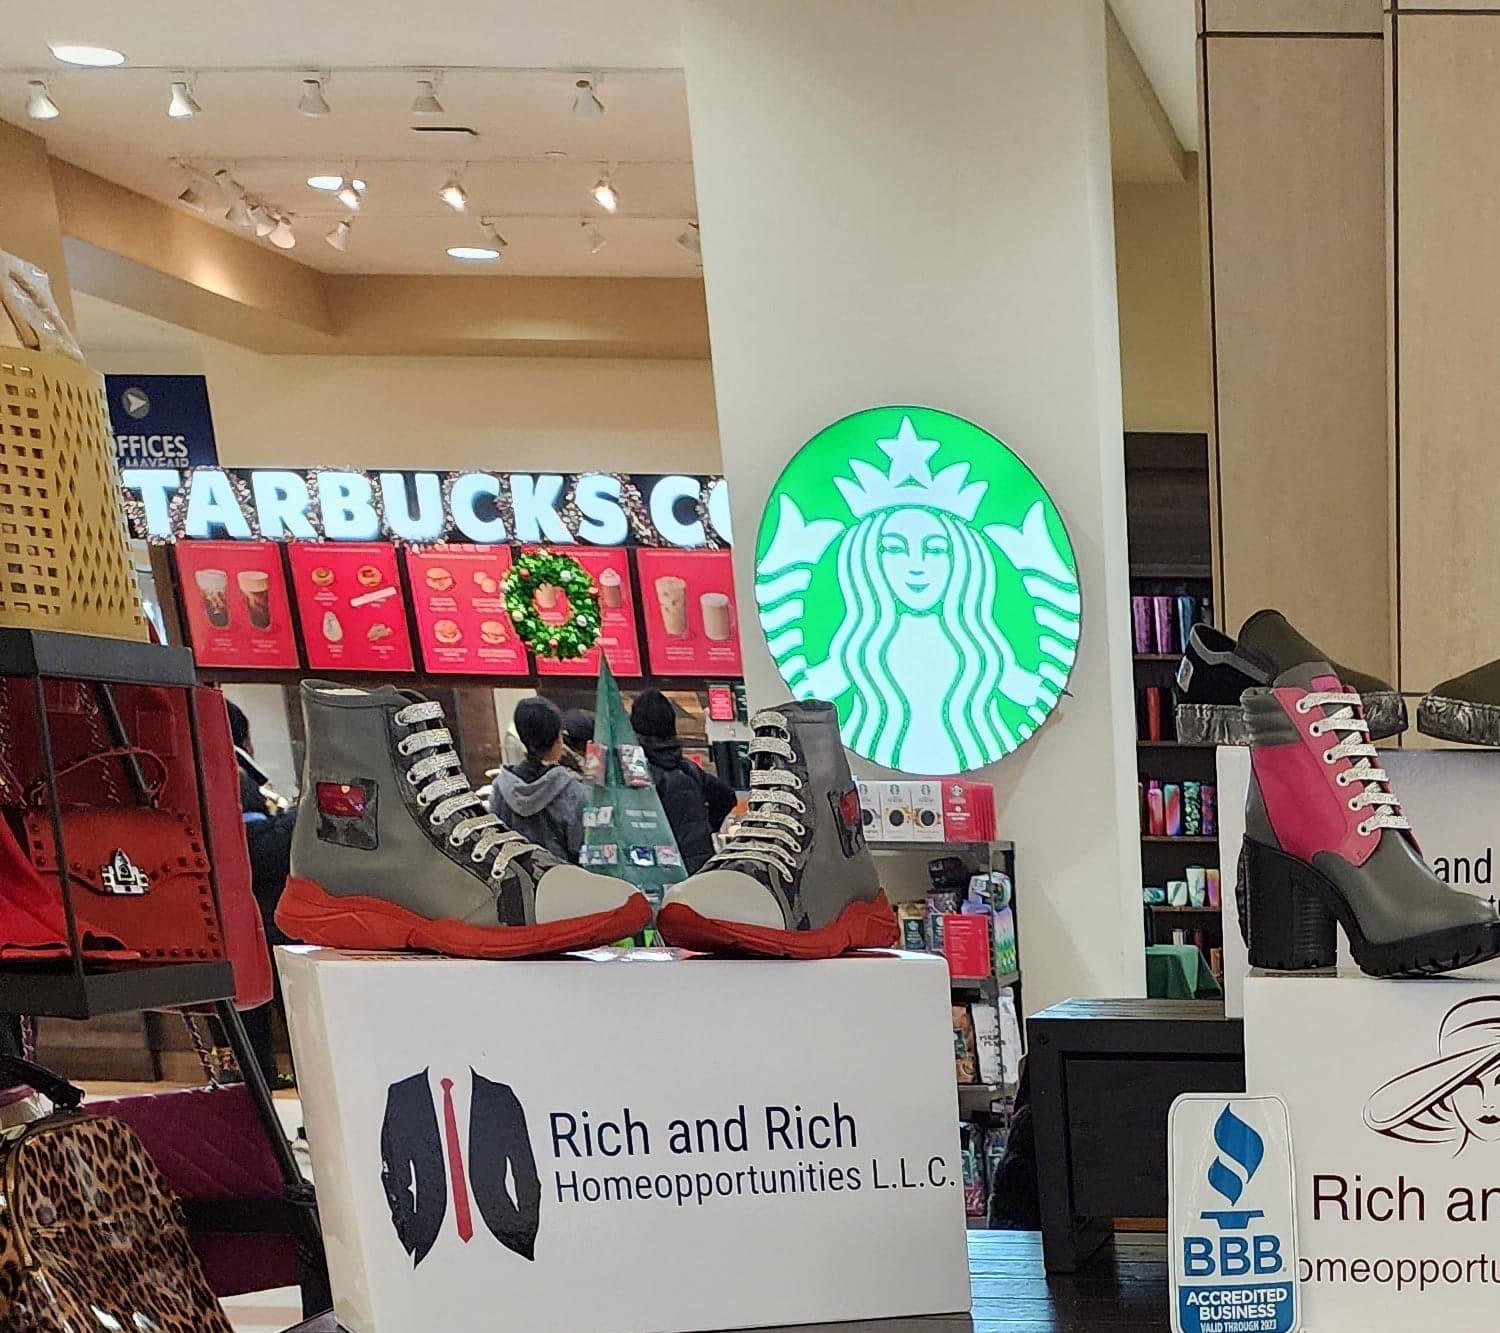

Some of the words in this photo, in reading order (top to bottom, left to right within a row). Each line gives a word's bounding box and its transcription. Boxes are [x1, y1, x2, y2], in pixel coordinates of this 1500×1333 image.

[120, 468, 629, 547] TARBUCKS
[1433, 847, 1492, 884] and
[549, 1107, 651, 1158] Rich
[667, 1104, 749, 1154] and
[765, 1102, 858, 1151] Rich
[554, 1160, 862, 1206] Homeopportunities
[871, 1156, 957, 1189] L.L.C.
[1311, 1174, 1426, 1221] Rich
[1183, 1234, 1284, 1277] BBB
[1186, 1287, 1288, 1307] ACCREDITED
[1199, 1303, 1276, 1321] BUSINESS
[1200, 1321, 1223, 1333] VALID
[1224, 1320, 1259, 1333] THROUGH
